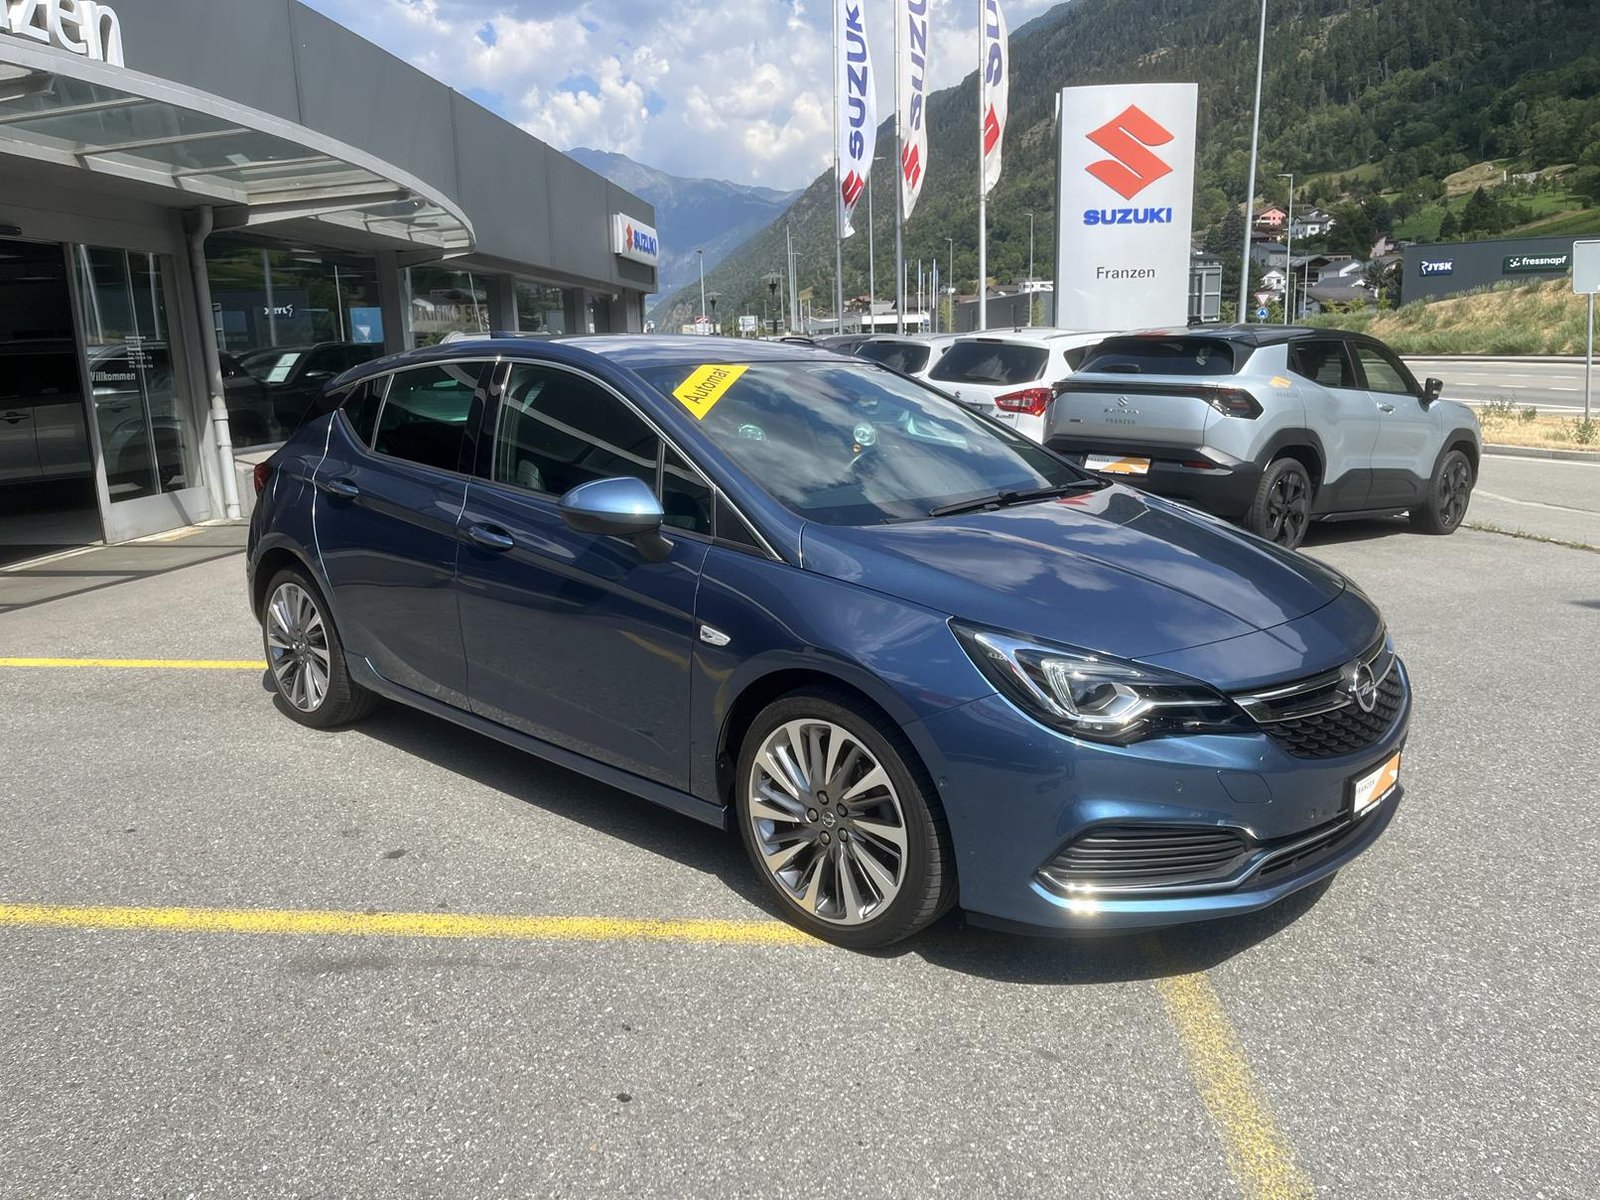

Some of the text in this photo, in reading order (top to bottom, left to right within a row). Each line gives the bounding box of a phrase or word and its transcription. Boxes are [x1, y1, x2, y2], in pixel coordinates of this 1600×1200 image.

[0, 0, 125, 69] zen
[1083, 207, 1172, 226] SUZUKI
[633, 230, 657, 256] SUZUKI
[1427, 261, 1453, 271] JYSK
[1521, 255, 1568, 267] fressnapf
[1096, 266, 1156, 279] Franzen
[683, 367, 731, 405] Automat
